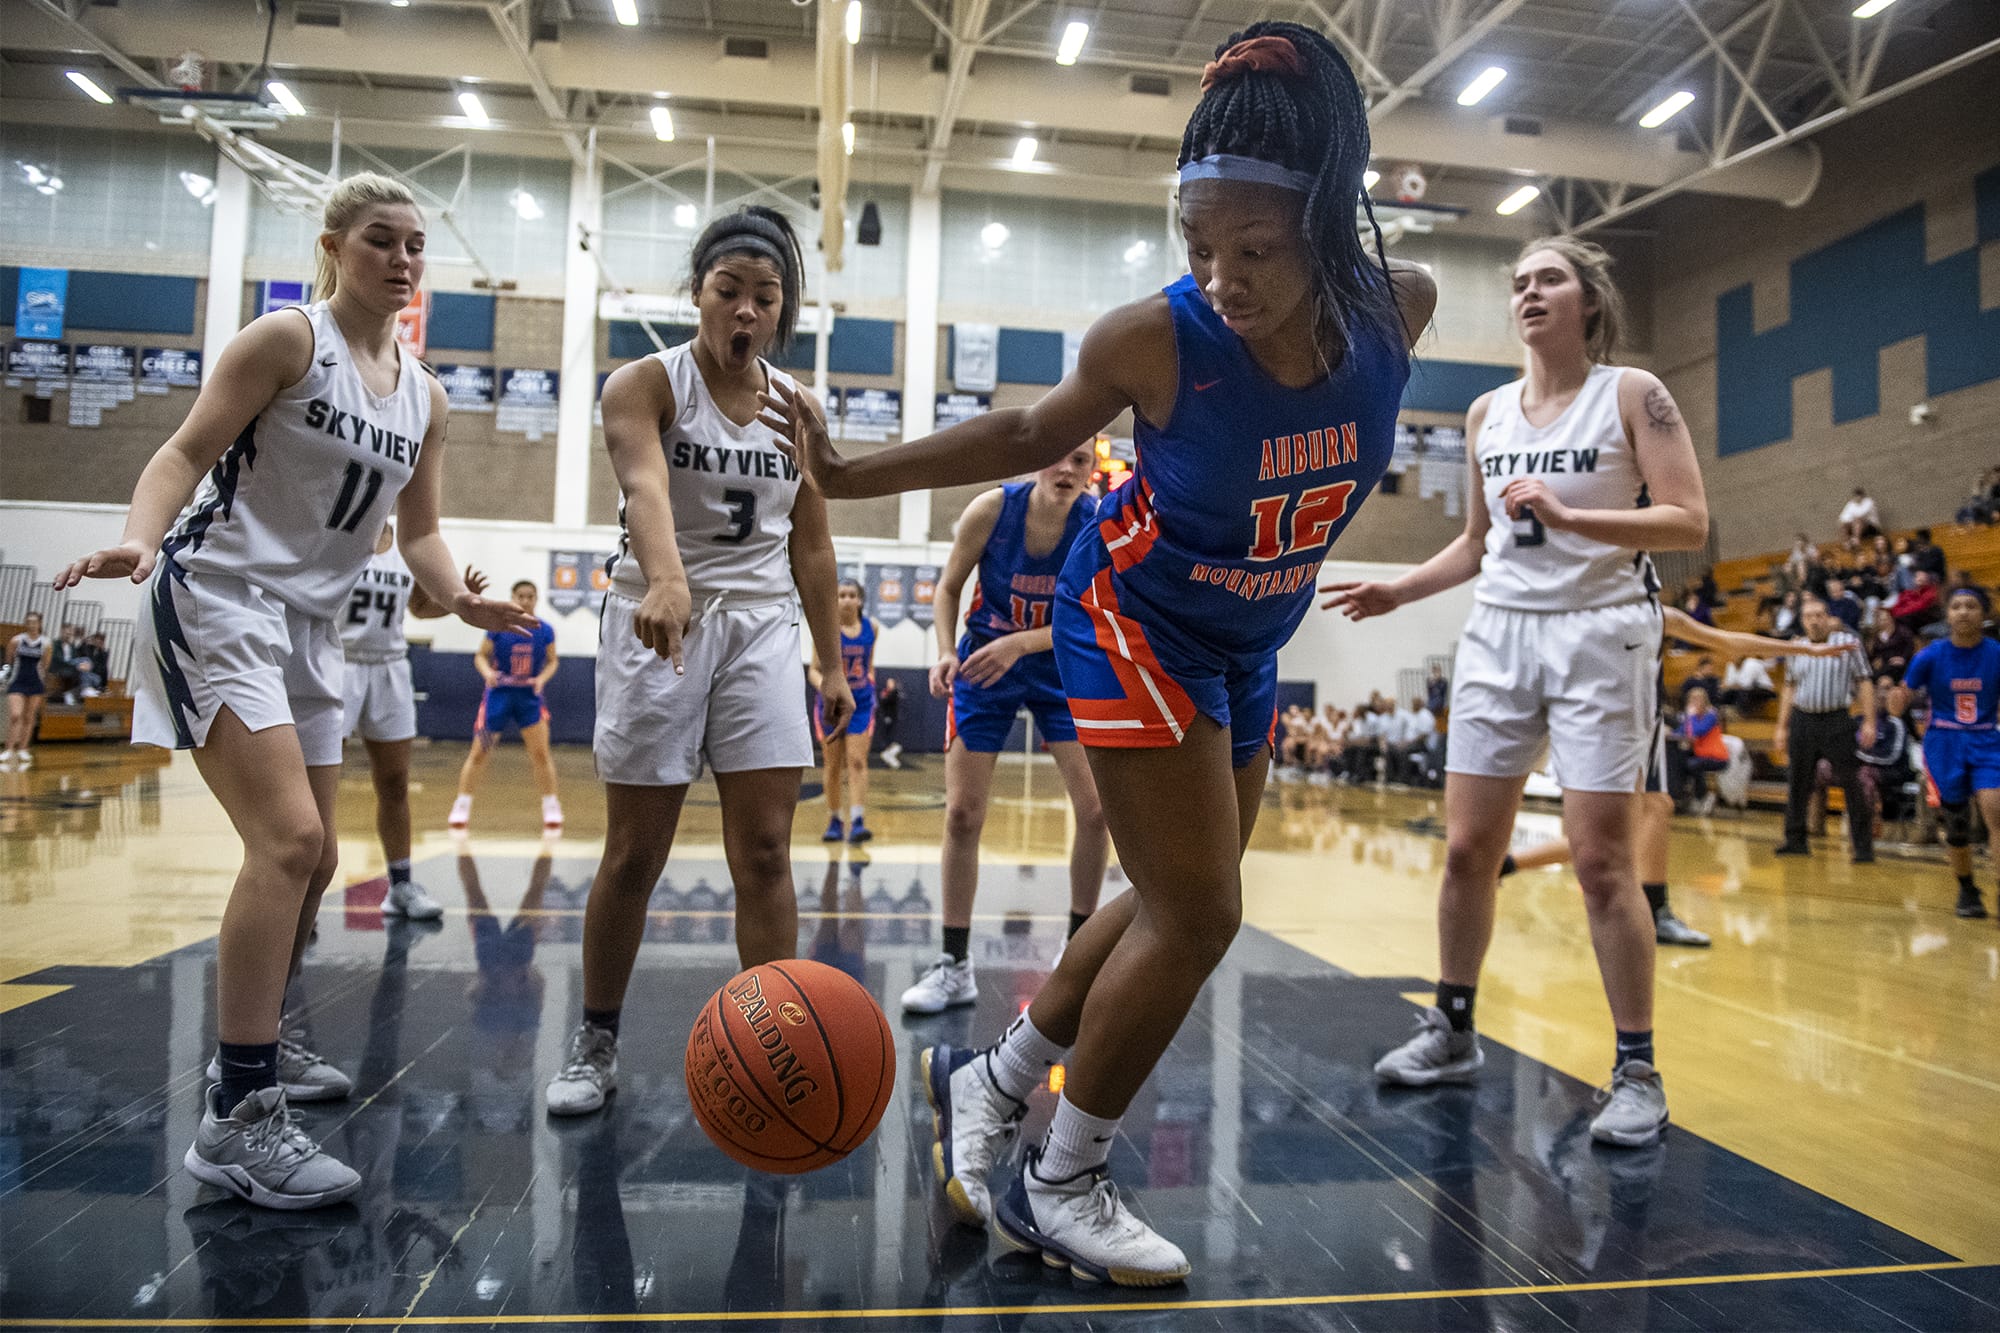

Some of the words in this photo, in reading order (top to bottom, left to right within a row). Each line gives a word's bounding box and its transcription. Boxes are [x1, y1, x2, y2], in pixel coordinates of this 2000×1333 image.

[142, 357, 199, 372] CHEER
[672, 441, 799, 482] SKYVIEW
[1258, 421, 1357, 481] AUBURN
[1484, 448, 1598, 478] SKYVIEW
[325, 458, 384, 534] 11
[711, 487, 757, 543] 3
[1244, 480, 1357, 562] 12
[361, 568, 410, 588] YVIEW
[1188, 562, 1322, 601] MOUNTAINV
[347, 588, 397, 628] 24
[1009, 594, 1049, 630] 11
[1954, 693, 1978, 724] 5
